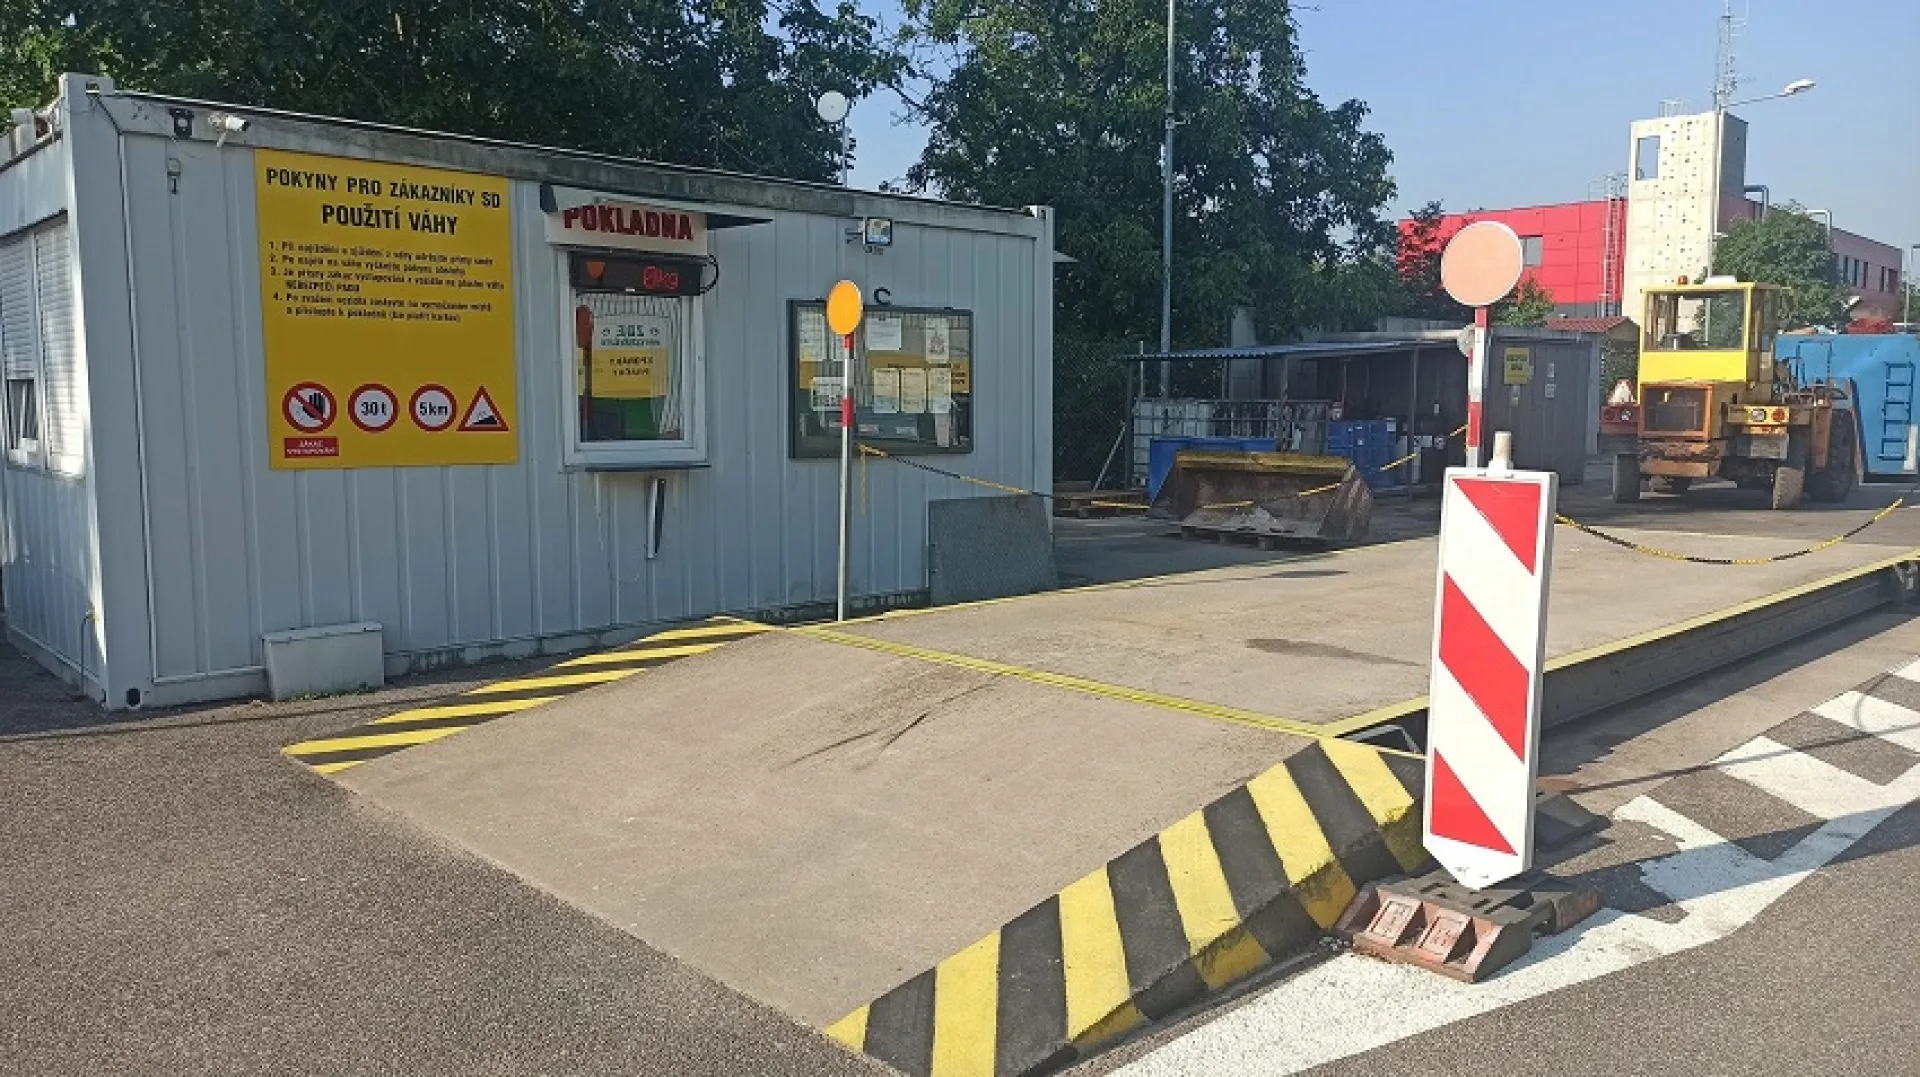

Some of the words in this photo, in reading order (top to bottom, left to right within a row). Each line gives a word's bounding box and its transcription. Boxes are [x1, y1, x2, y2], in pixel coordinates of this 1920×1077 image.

[266, 168, 338, 193] POKYNY
[347, 177, 381, 196] PRO
[390, 178, 475, 207] ZÁKAZNÍKY
[322, 204, 401, 231] POUŽITÍ
[408, 211, 459, 235] VÁHY
[564, 205, 694, 241] POKLADNA
